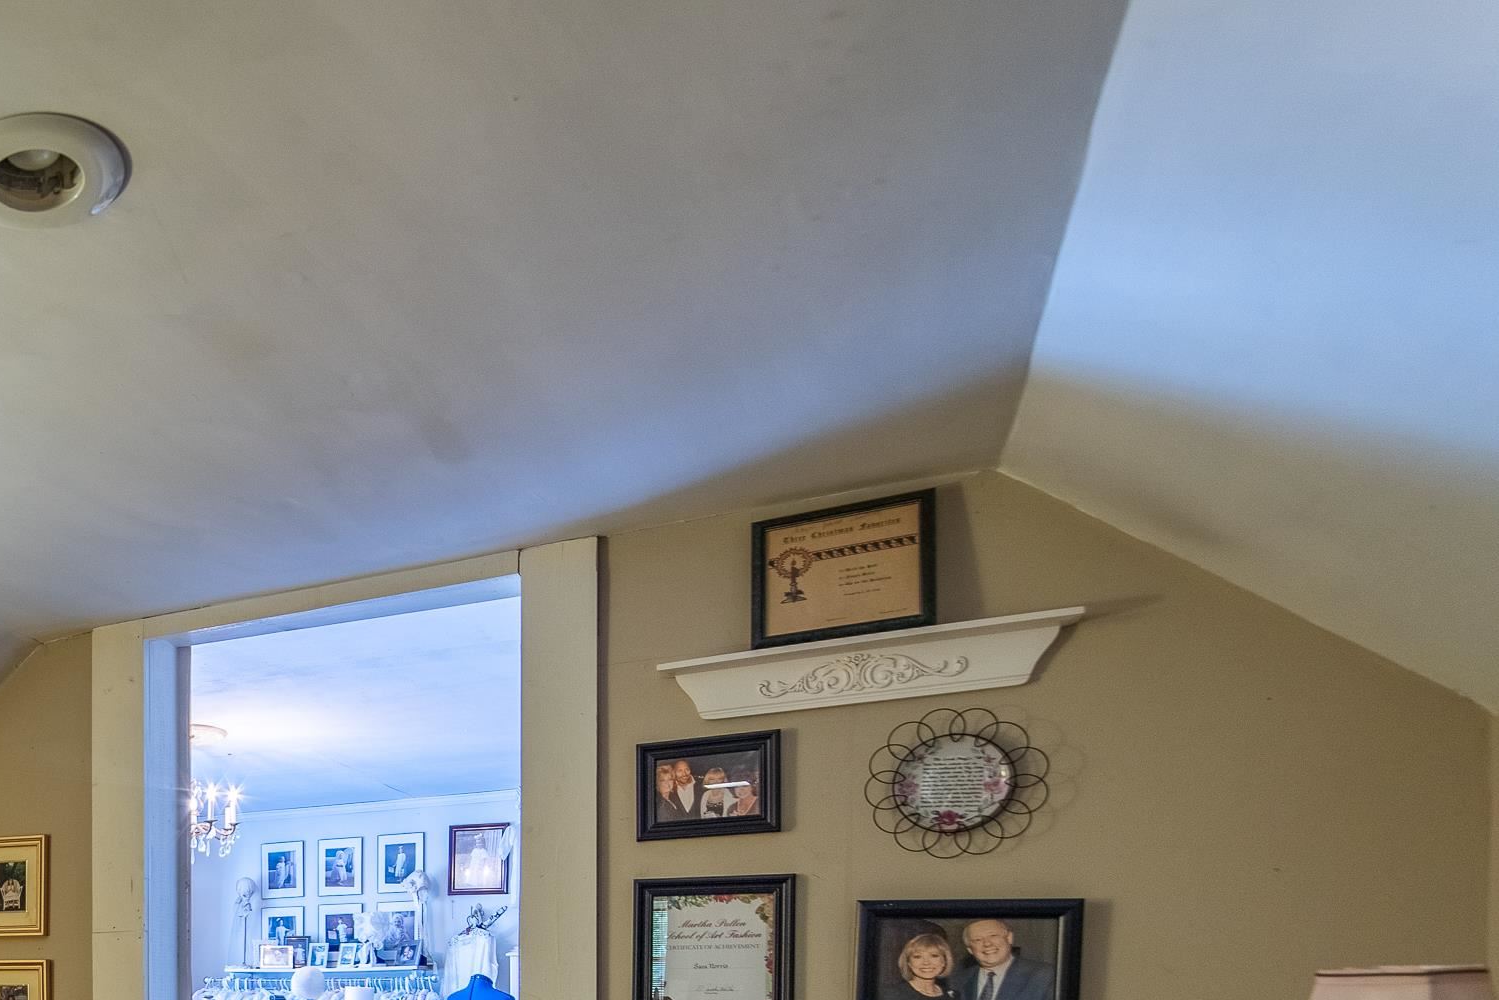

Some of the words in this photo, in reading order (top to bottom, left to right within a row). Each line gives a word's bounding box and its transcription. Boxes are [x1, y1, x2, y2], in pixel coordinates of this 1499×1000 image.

[678, 919, 712, 929] Martha
[695, 930, 708, 941] of
[725, 929, 762, 939] Fashion
